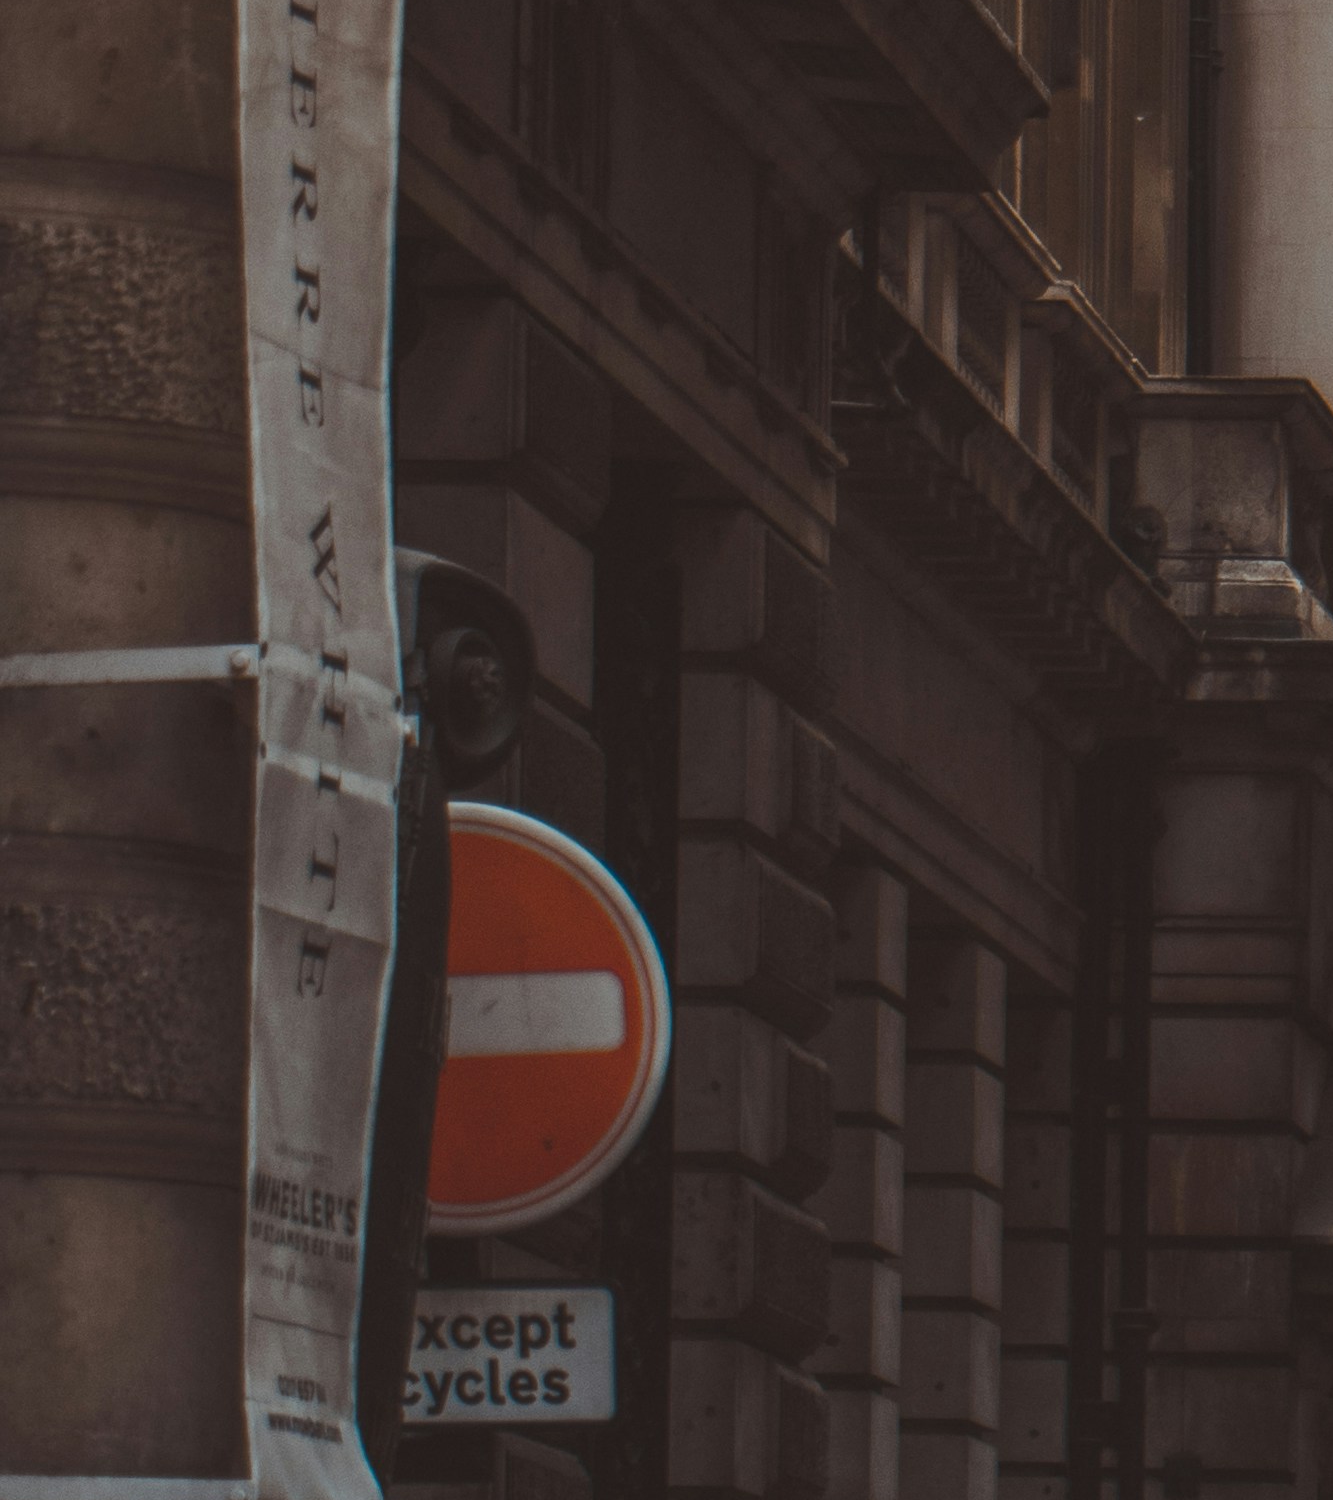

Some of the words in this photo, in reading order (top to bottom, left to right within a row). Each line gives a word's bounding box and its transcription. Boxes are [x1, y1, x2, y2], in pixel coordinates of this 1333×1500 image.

[296, 500, 348, 998] WHITE
[253, 1171, 358, 1237] WHEELER'S
[416, 1301, 577, 1358] xcept
